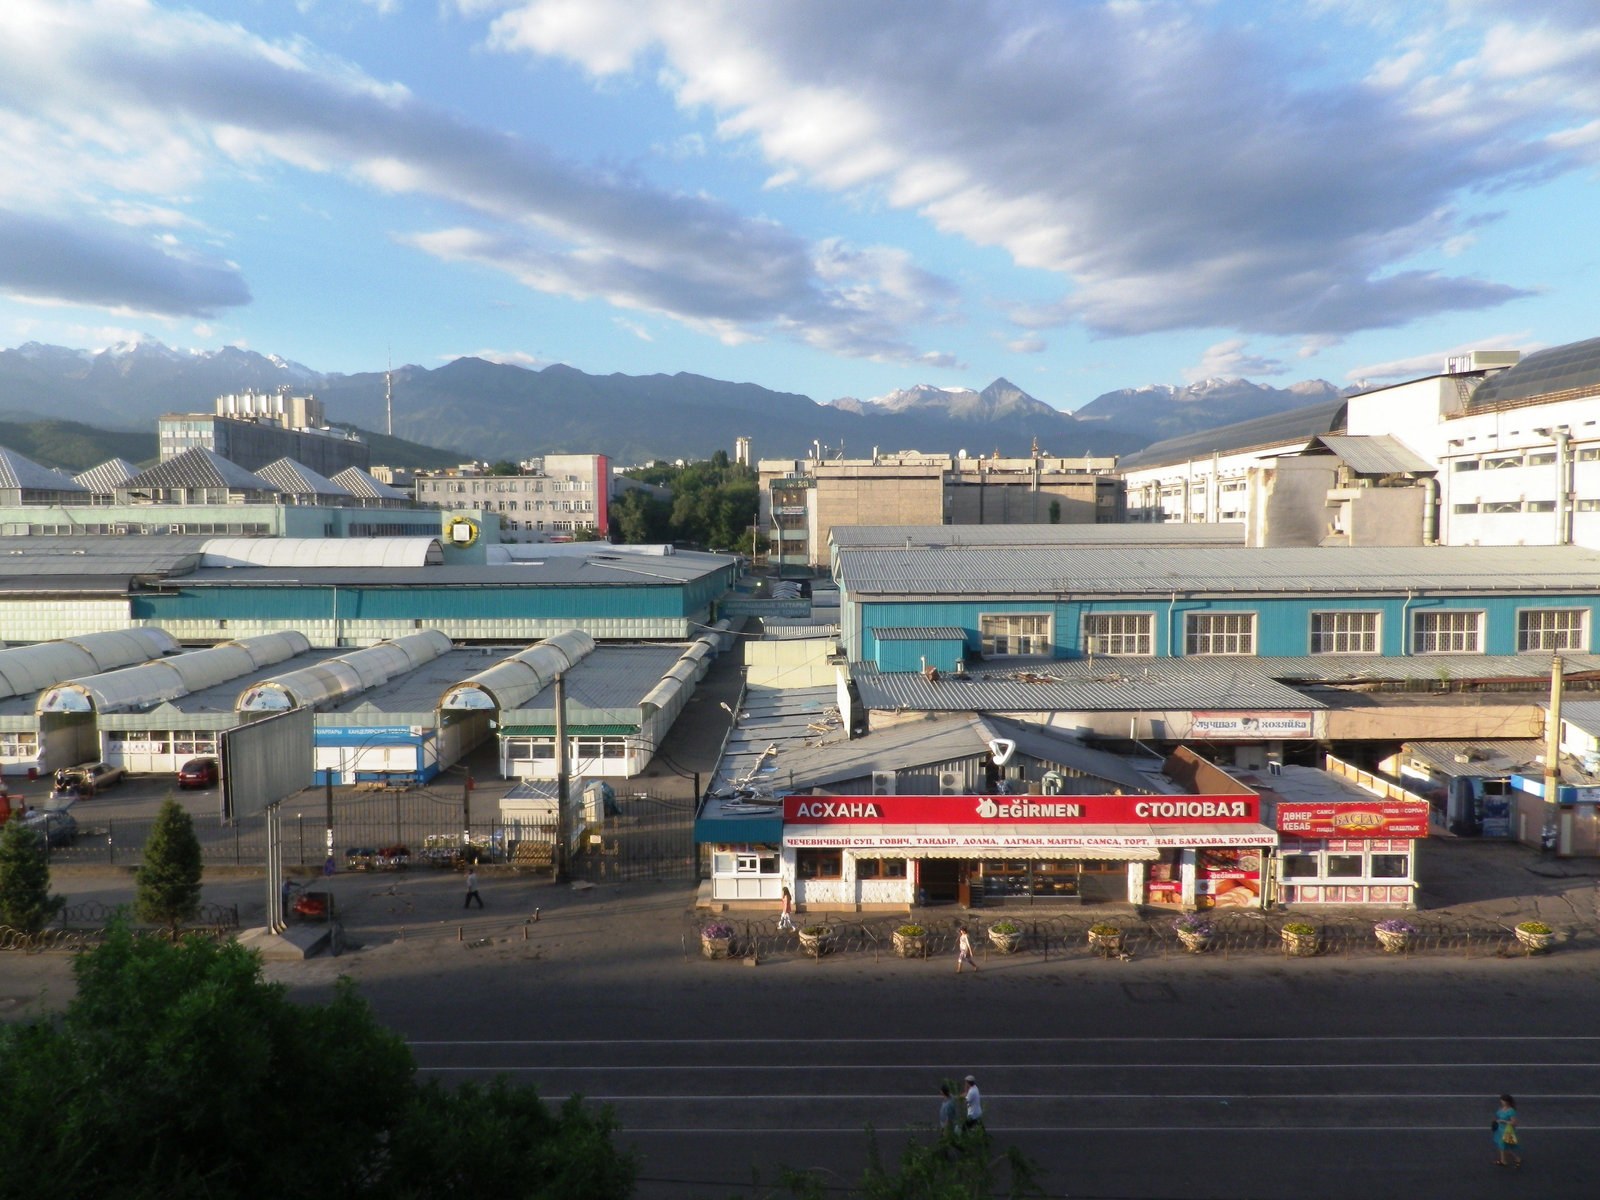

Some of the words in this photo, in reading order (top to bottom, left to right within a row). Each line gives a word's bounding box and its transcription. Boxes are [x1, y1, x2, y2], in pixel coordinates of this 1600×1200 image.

[1262, 719, 1307, 728] хозяйка
[796, 802, 878, 818] АСХАНА
[1135, 801, 1245, 818] СТОЛОВАЯ
[1282, 821, 1312, 832] КЕБАБ
[787, 837, 851, 846] ЧЕЧЕВИЧНЫЙ
[1229, 837, 1273, 845] БУЛОЧКИ
